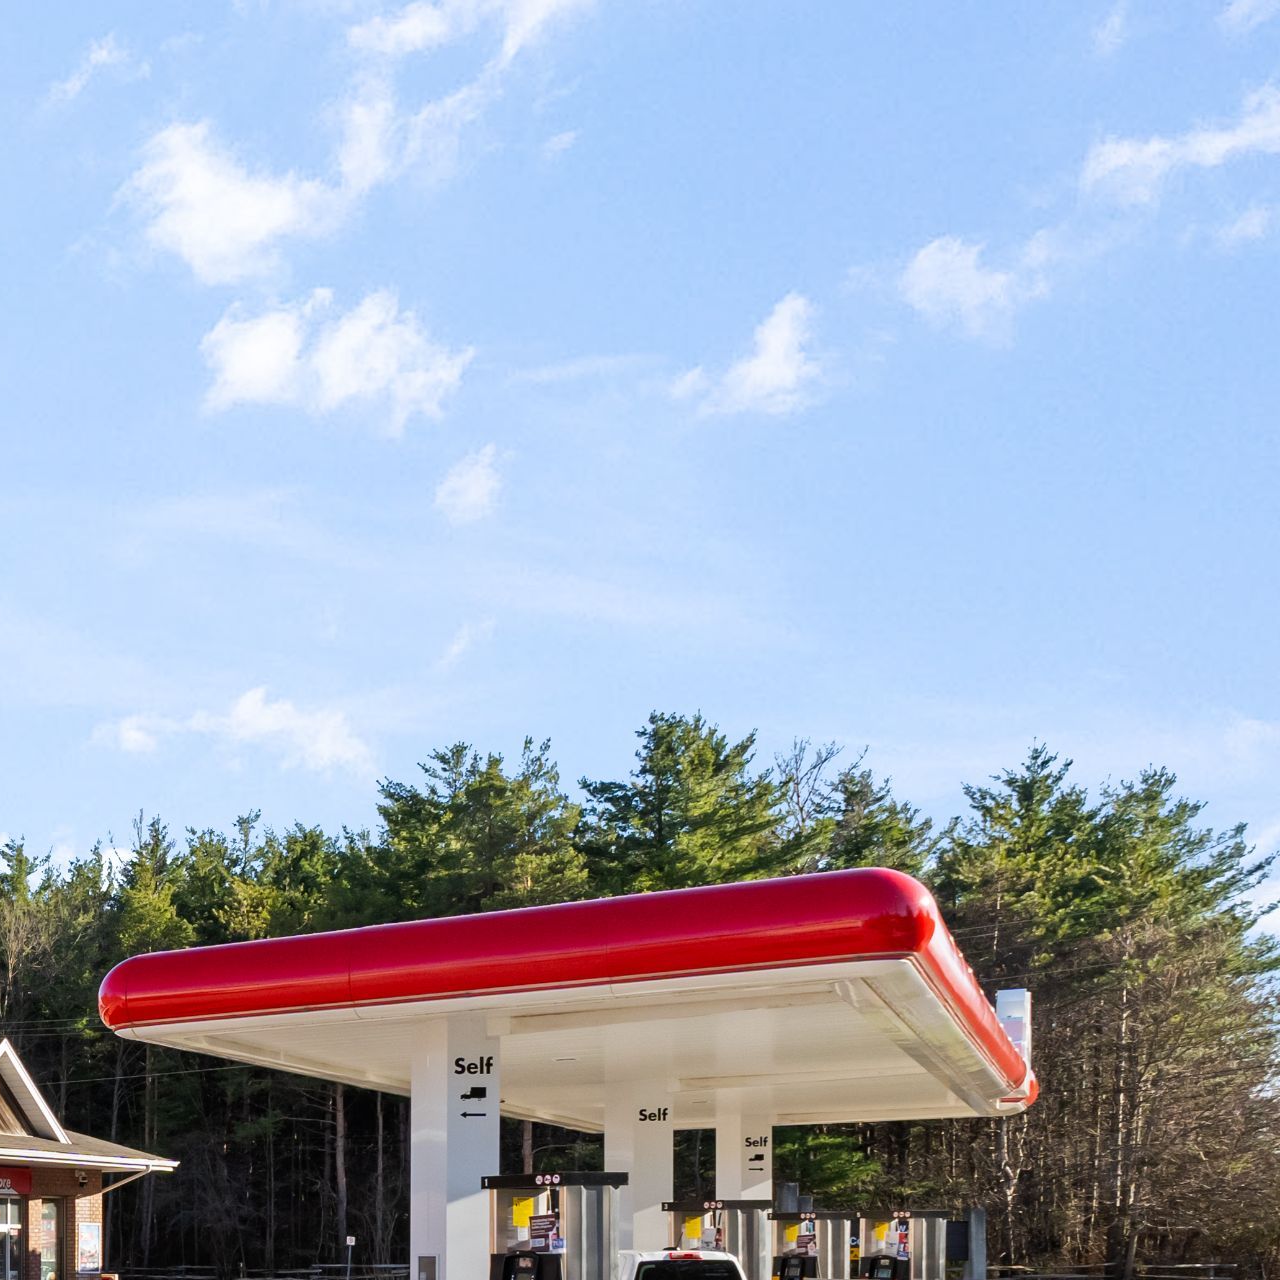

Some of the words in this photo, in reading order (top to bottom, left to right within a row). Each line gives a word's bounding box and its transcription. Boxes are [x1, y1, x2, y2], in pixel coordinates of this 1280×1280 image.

[453, 1055, 494, 1075] Self
[638, 1107, 669, 1122] Self
[744, 1136, 769, 1148] Self
